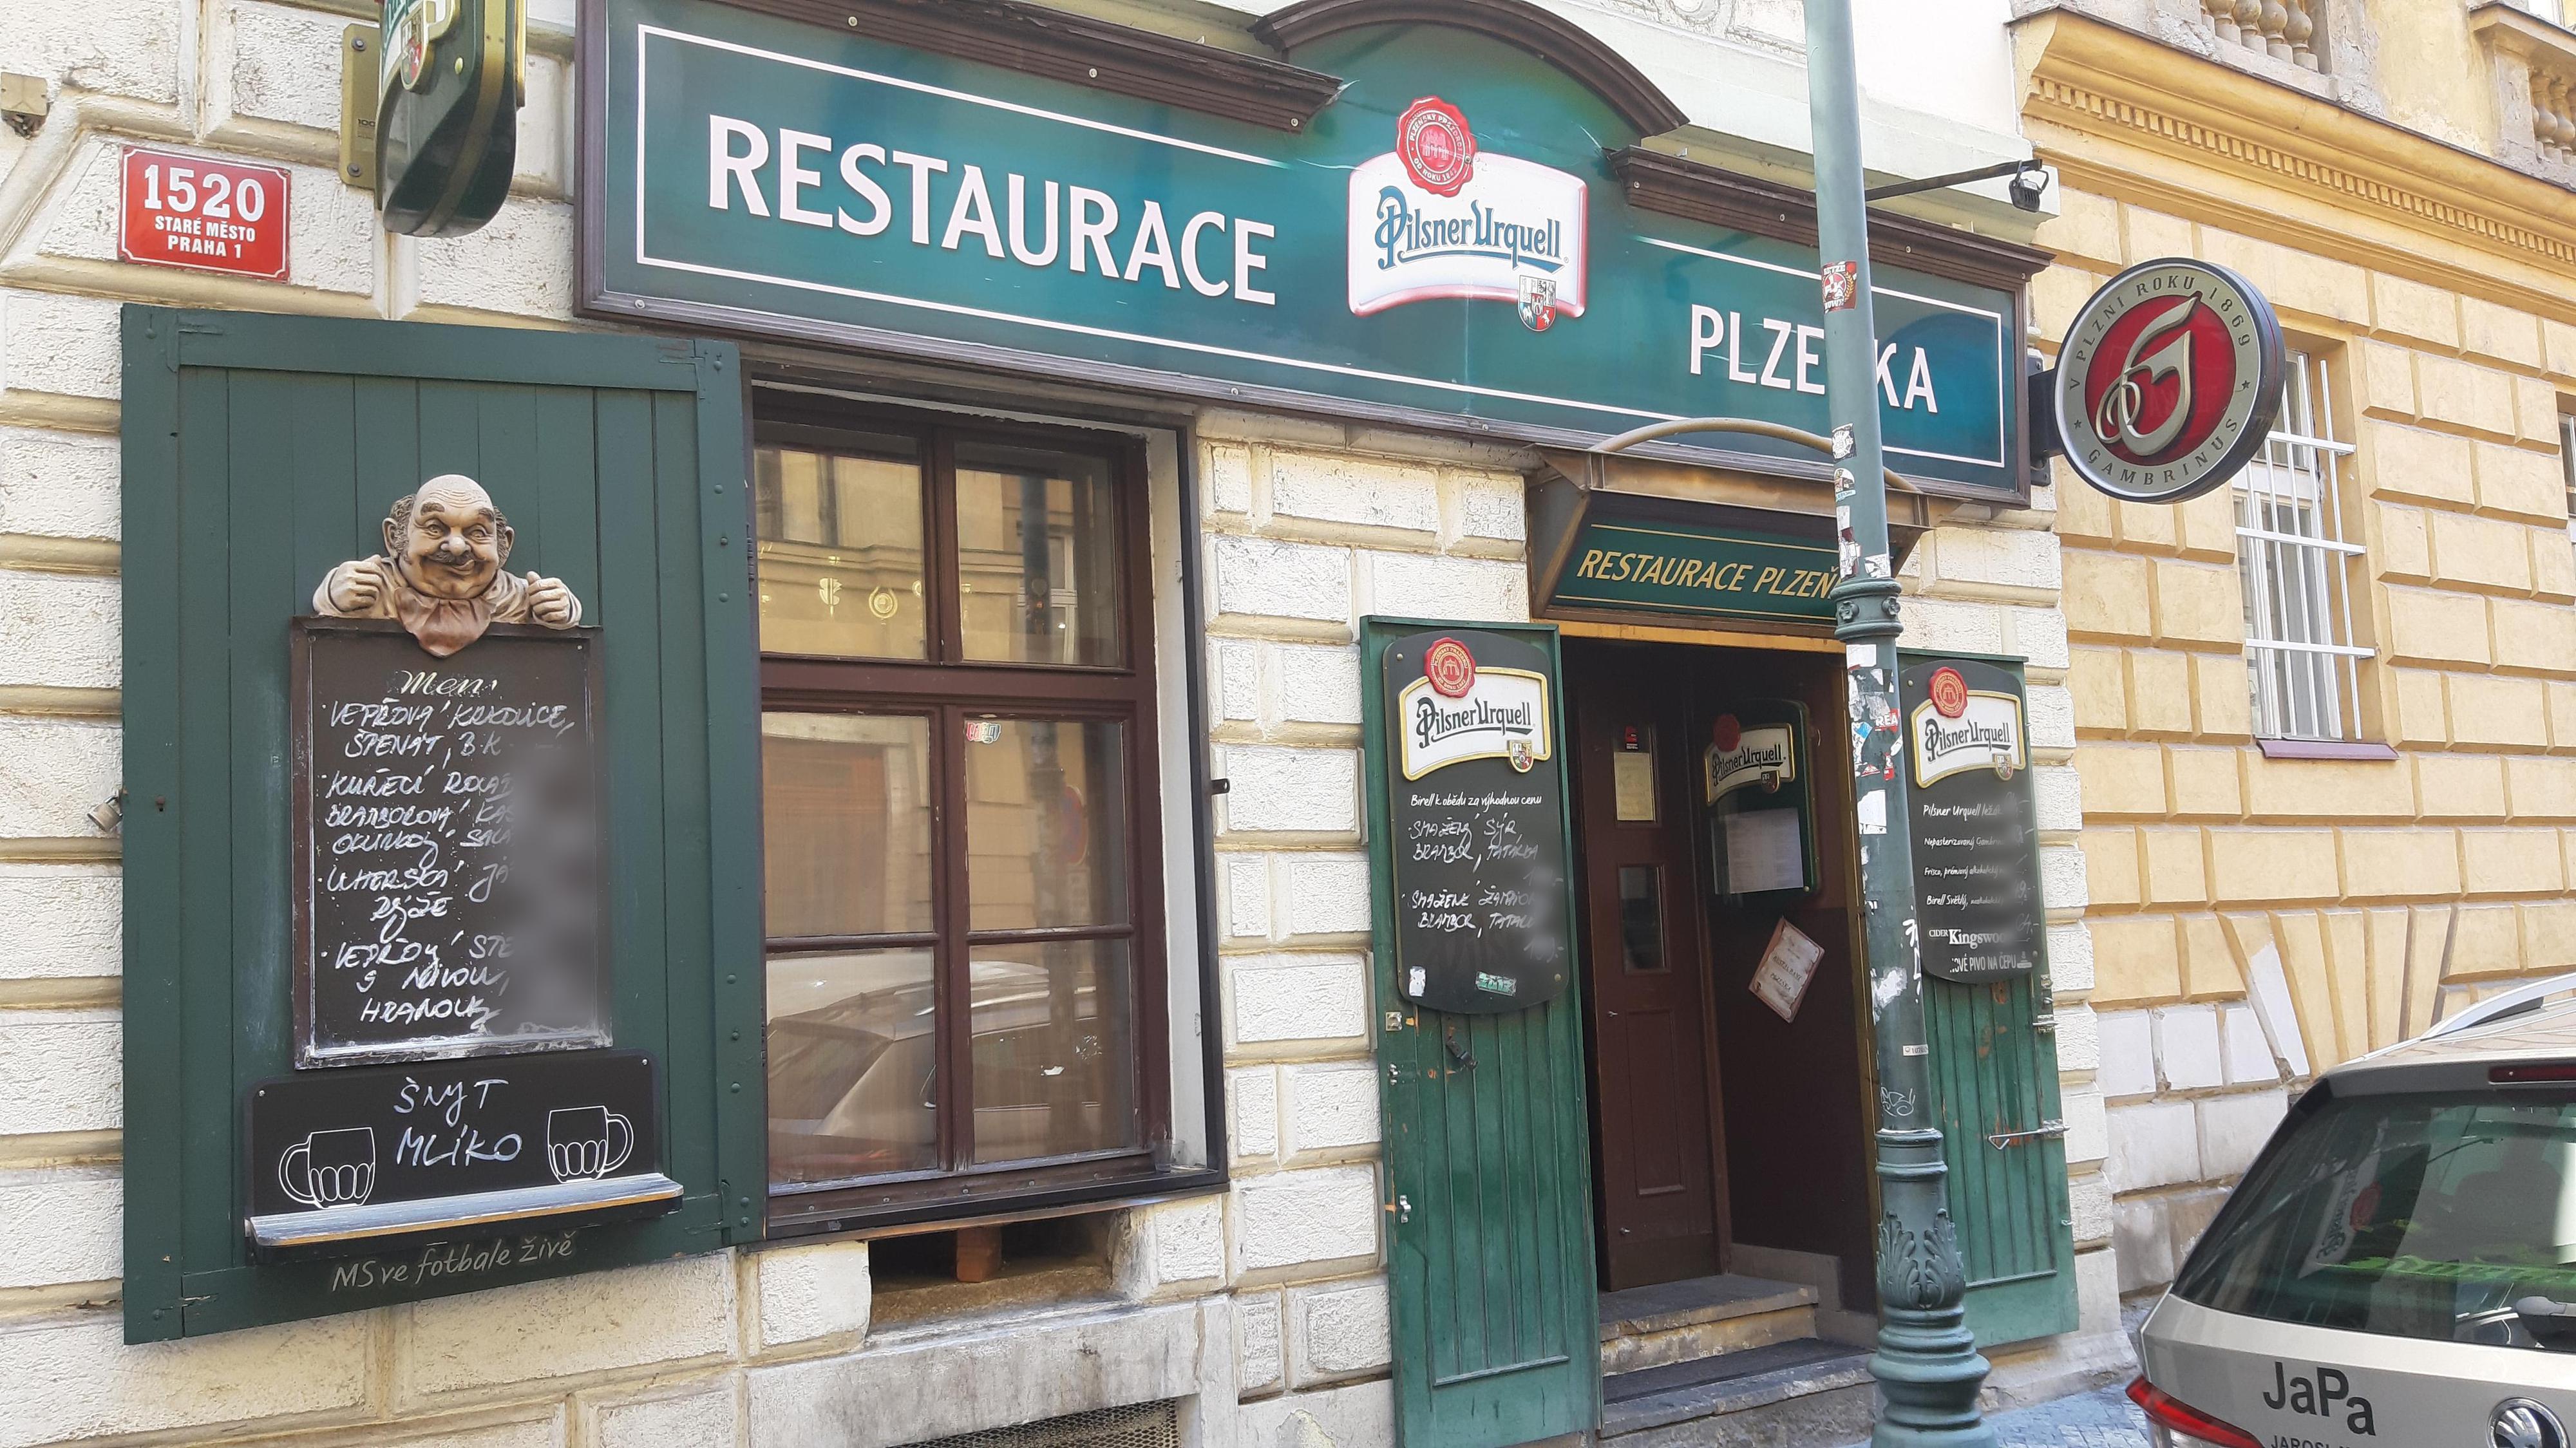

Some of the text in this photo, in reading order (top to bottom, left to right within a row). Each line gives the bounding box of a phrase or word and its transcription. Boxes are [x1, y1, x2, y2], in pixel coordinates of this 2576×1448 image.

[144, 164, 265, 222] 1520
[709, 114, 1276, 306] RESTAURACE
[155, 214, 256, 243] STARÉ MĚSTO
[167, 234, 242, 259] PRAHA 1
[1375, 185, 1562, 271] Pilsner Urquell
[2069, 274, 2251, 390] V PLZNI ROKU 1869
[1690, 304, 1938, 413] PLZEKA
[2088, 418, 2238, 485] GAMBRINUS
[1577, 549, 1754, 593] RESTAURACE
[1755, 565, 1840, 600] PLZEŇ
[1416, 697, 1531, 749] Pilsner Urquell
[1925, 719, 2011, 762] Pilsner Urquell
[1712, 744, 1782, 787] Pilsner Urquell
[1410, 790, 1542, 813] Birell k obědu za výhodnou cenu
[1923, 804, 1951, 820] Pilsner
[1952, 804, 1982, 822] Urquell
[1926, 894, 1946, 906] Birell
[1929, 928, 2007, 949] CIDER Kingswoo
[1969, 956, 1986, 972] PIVO
[1987, 955, 1999, 971] NA
[1998, 952, 2017, 970] ČEPU
[396, 1124, 522, 1167] MLÍKO
[332, 1263, 375, 1292] MS
[380, 1263, 410, 1283] ve
[413, 1239, 512, 1286] fotbale
[2262, 1361, 2377, 1437] JaPa
